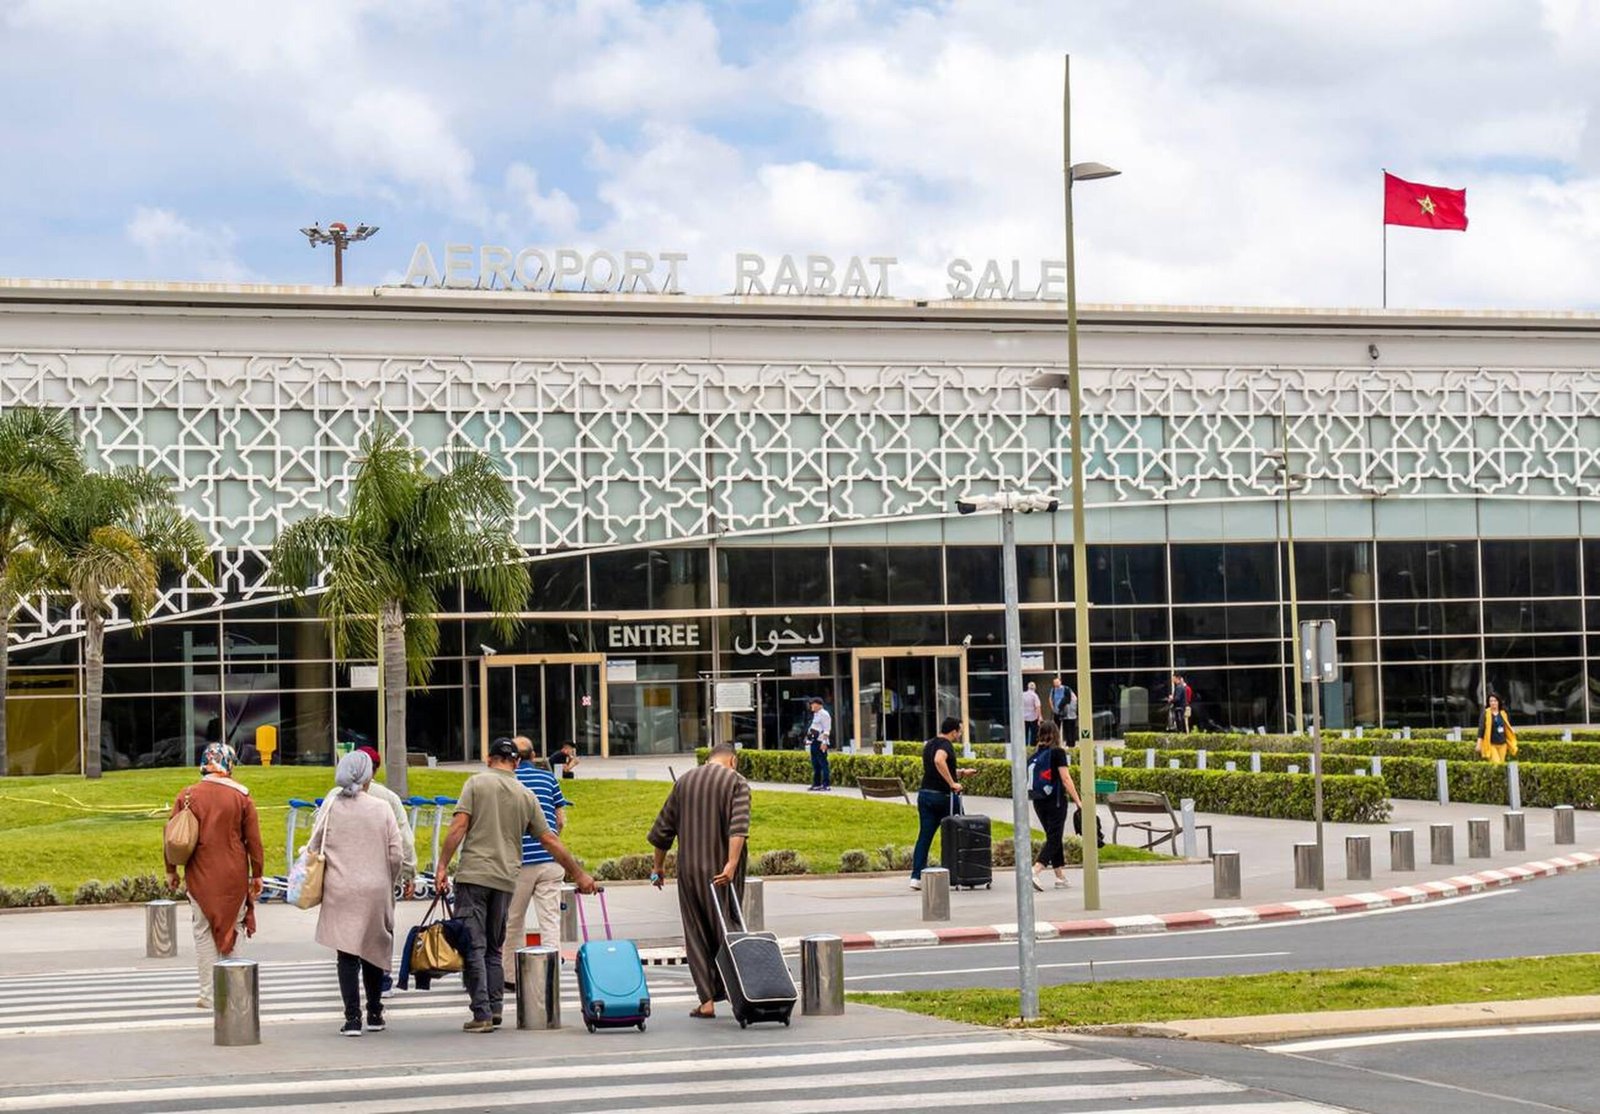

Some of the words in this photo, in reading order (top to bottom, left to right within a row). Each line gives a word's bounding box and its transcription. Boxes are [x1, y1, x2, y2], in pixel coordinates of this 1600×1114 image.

[404, 241, 688, 293] AEROPORT
[735, 252, 898, 297] RABAT
[946, 258, 1066, 299] SALE
[608, 624, 700, 648] ENTREE
[735, 616, 825, 656] دخول
